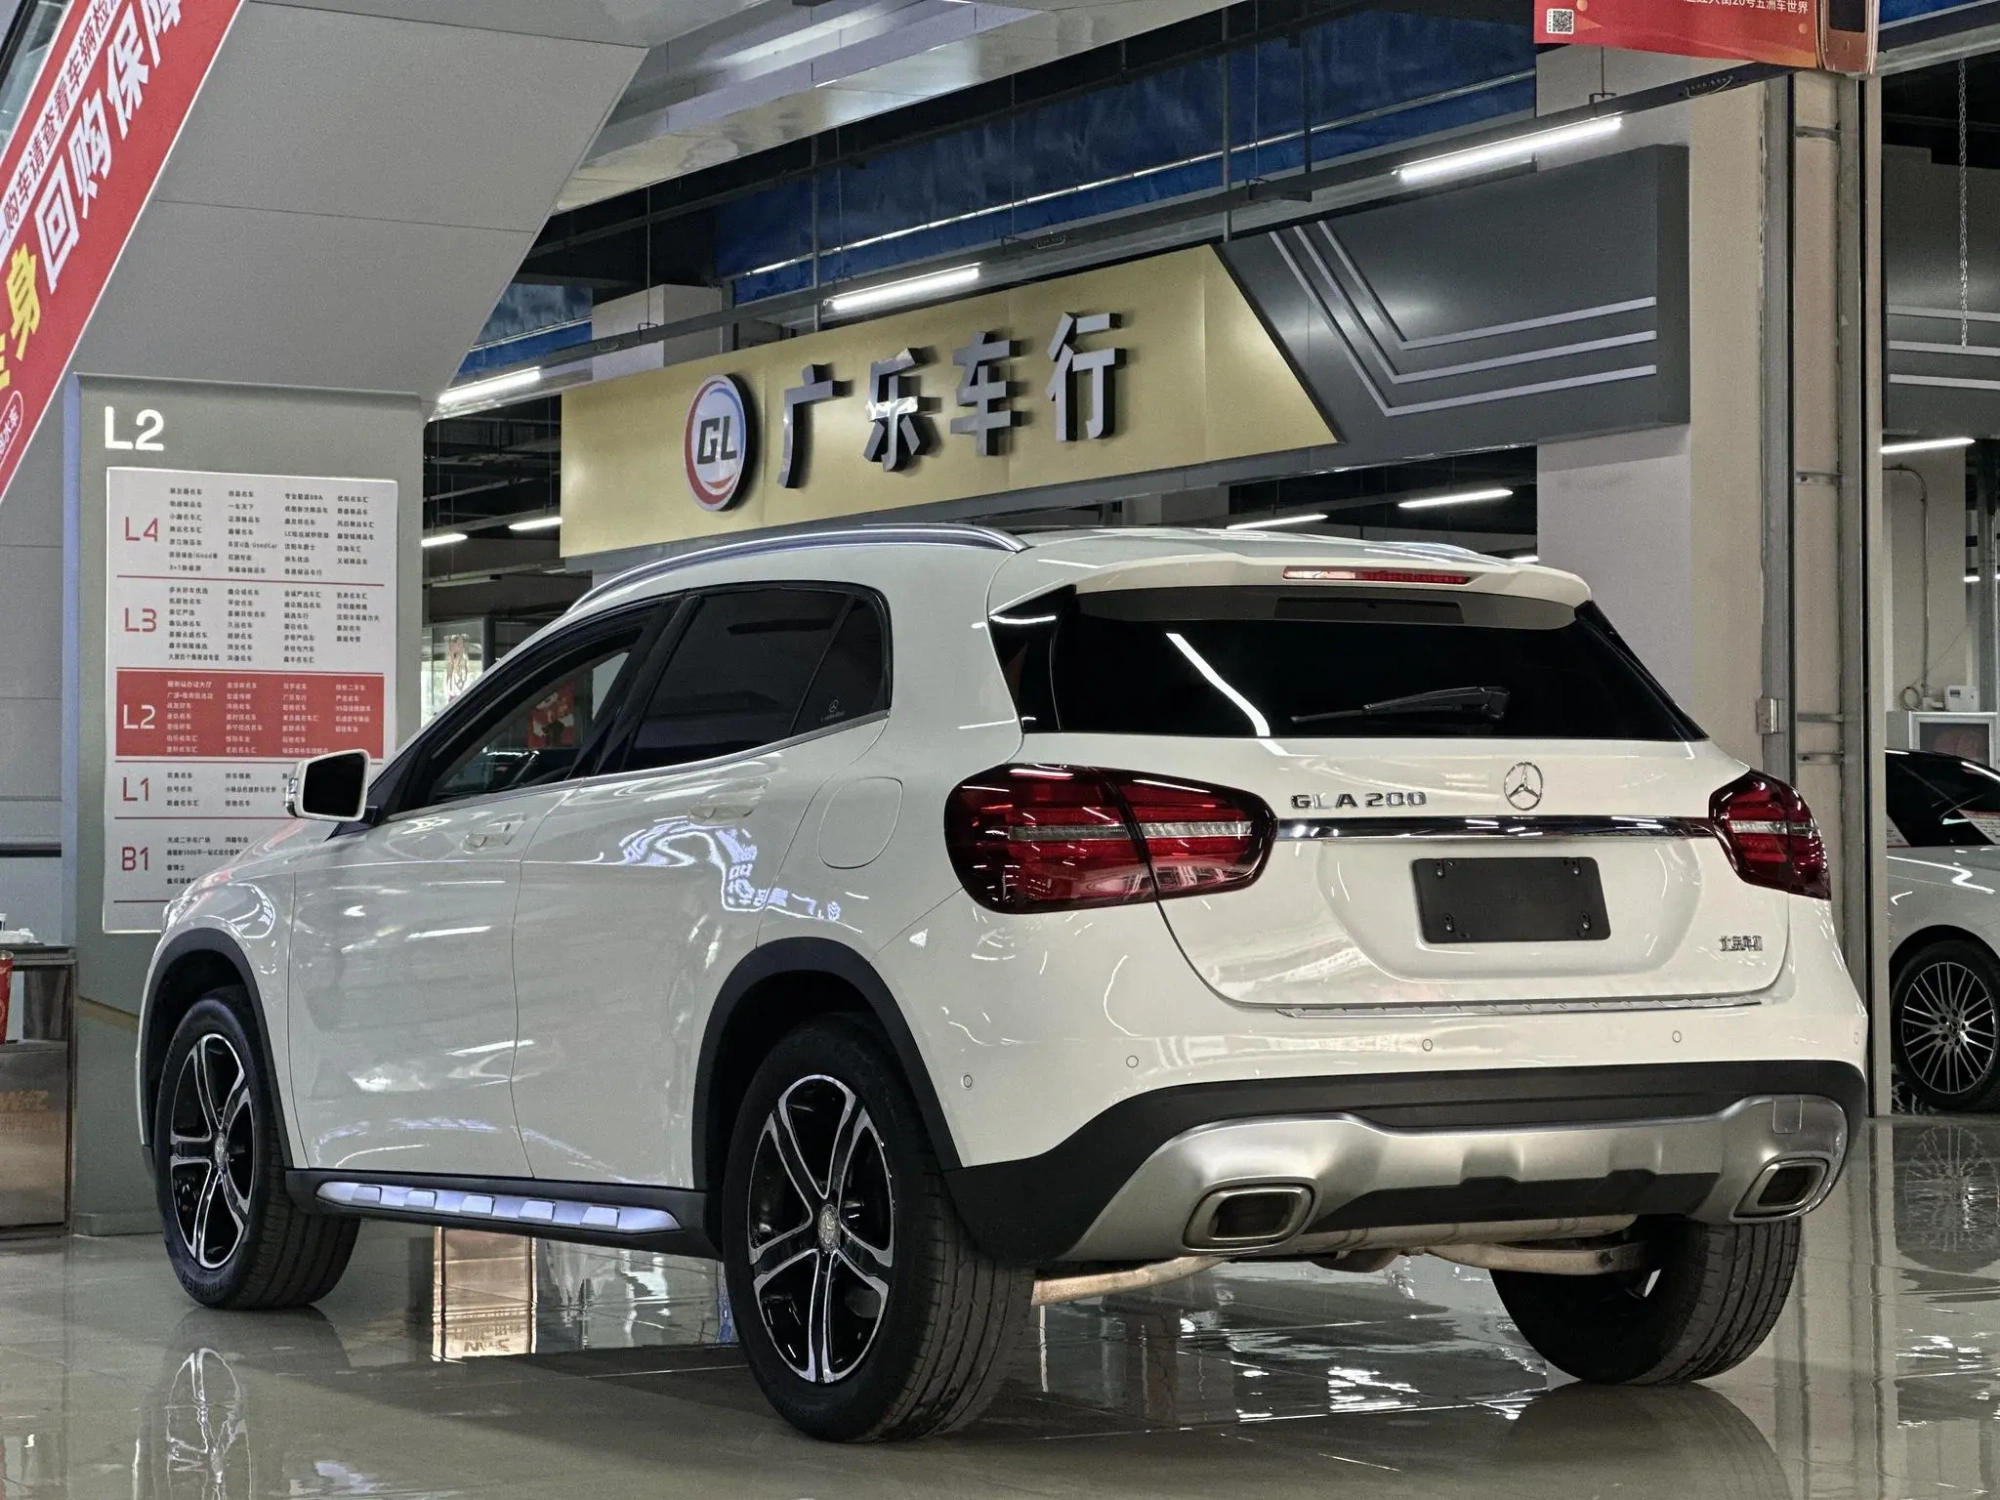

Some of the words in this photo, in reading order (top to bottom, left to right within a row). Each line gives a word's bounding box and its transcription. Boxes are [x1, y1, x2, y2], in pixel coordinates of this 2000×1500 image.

[0, 0, 121, 241] 购车请查看车辆检
[778, 312, 1126, 488] 广乐车行
[105, 406, 164, 450] L2
[697, 416, 737, 465] GL
[125, 516, 159, 541] L4
[125, 608, 157, 632] L3
[123, 704, 156, 730] L2
[122, 777, 150, 801] L1
[1290, 793, 1359, 810] GLA
[1364, 791, 1428, 808] 200
[121, 846, 149, 871] B1
